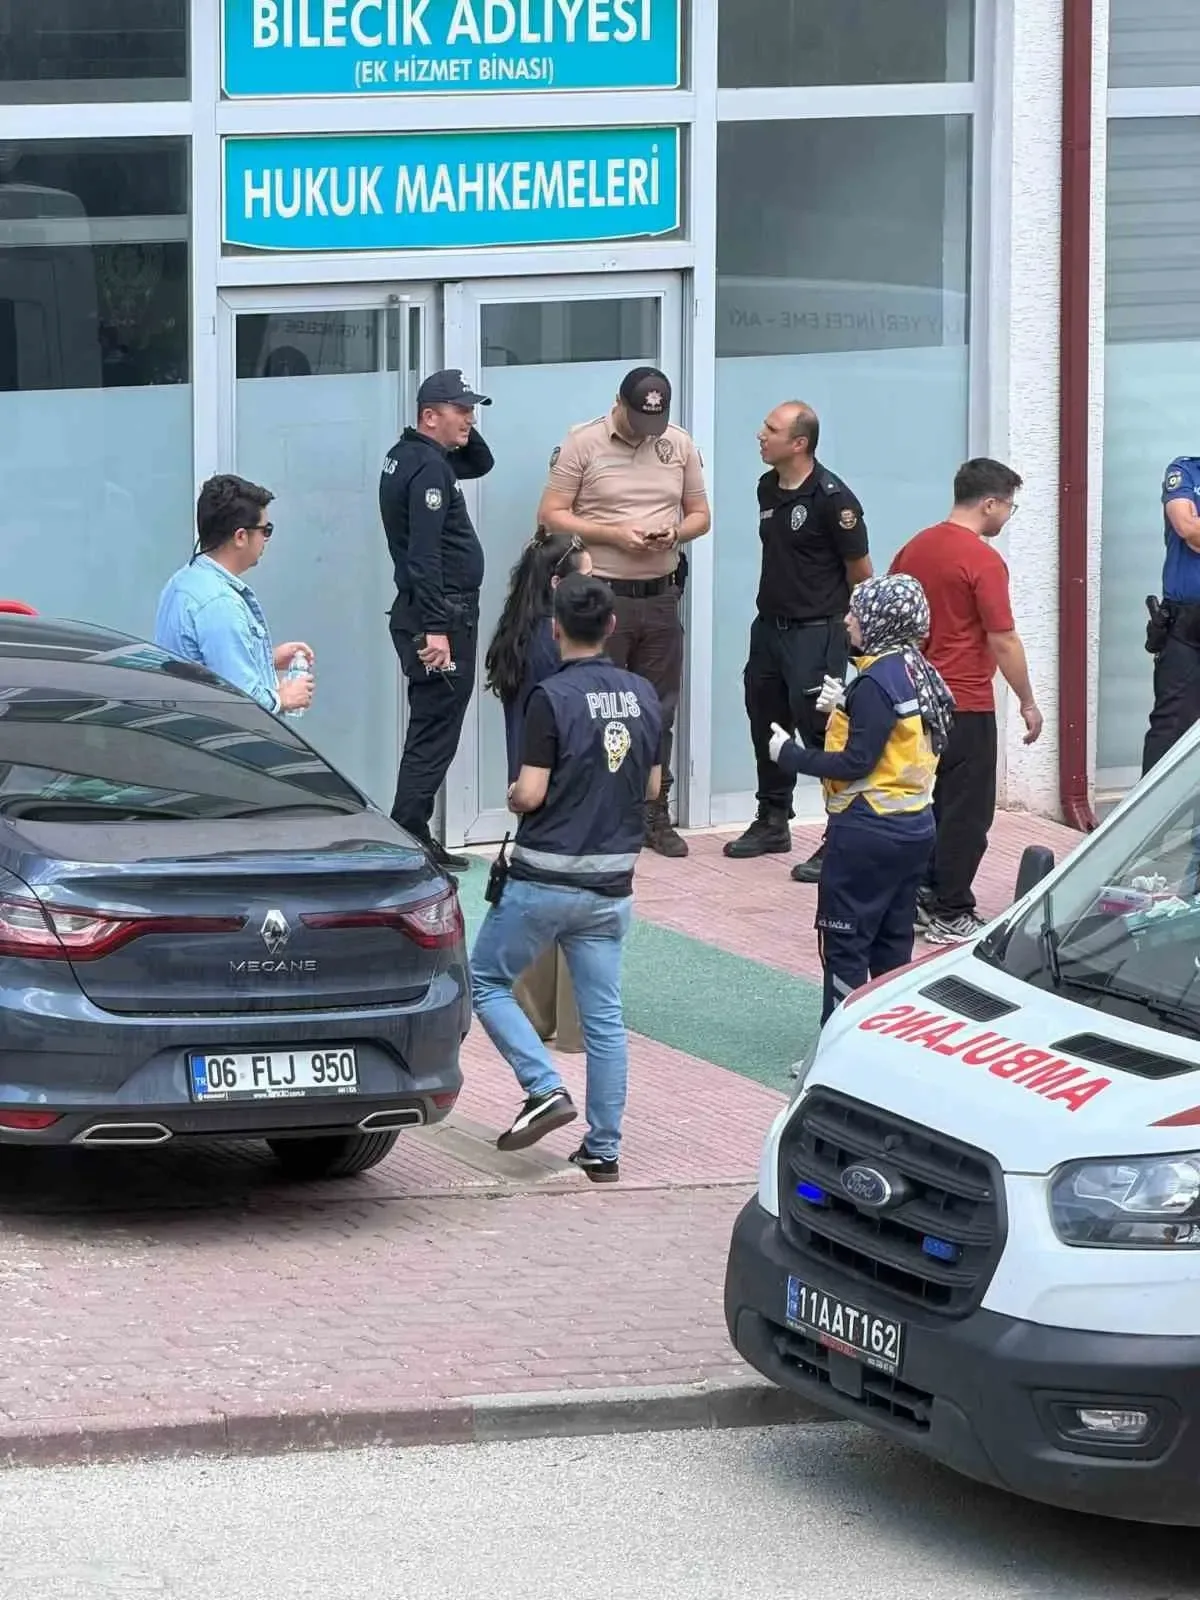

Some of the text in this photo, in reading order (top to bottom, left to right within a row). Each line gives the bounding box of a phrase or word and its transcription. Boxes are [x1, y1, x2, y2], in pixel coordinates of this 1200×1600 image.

[355, 53, 554, 88] (EK HİZMET BİNASI)
[244, 143, 660, 219] HUKUK MAHKEMELERİ
[229, 960, 317, 972] MEGANE
[207, 1057, 237, 1088] 06
[251, 1054, 295, 1087] FLJ
[311, 1052, 354, 1083] 950
[847, 1171, 876, 1198] Ford
